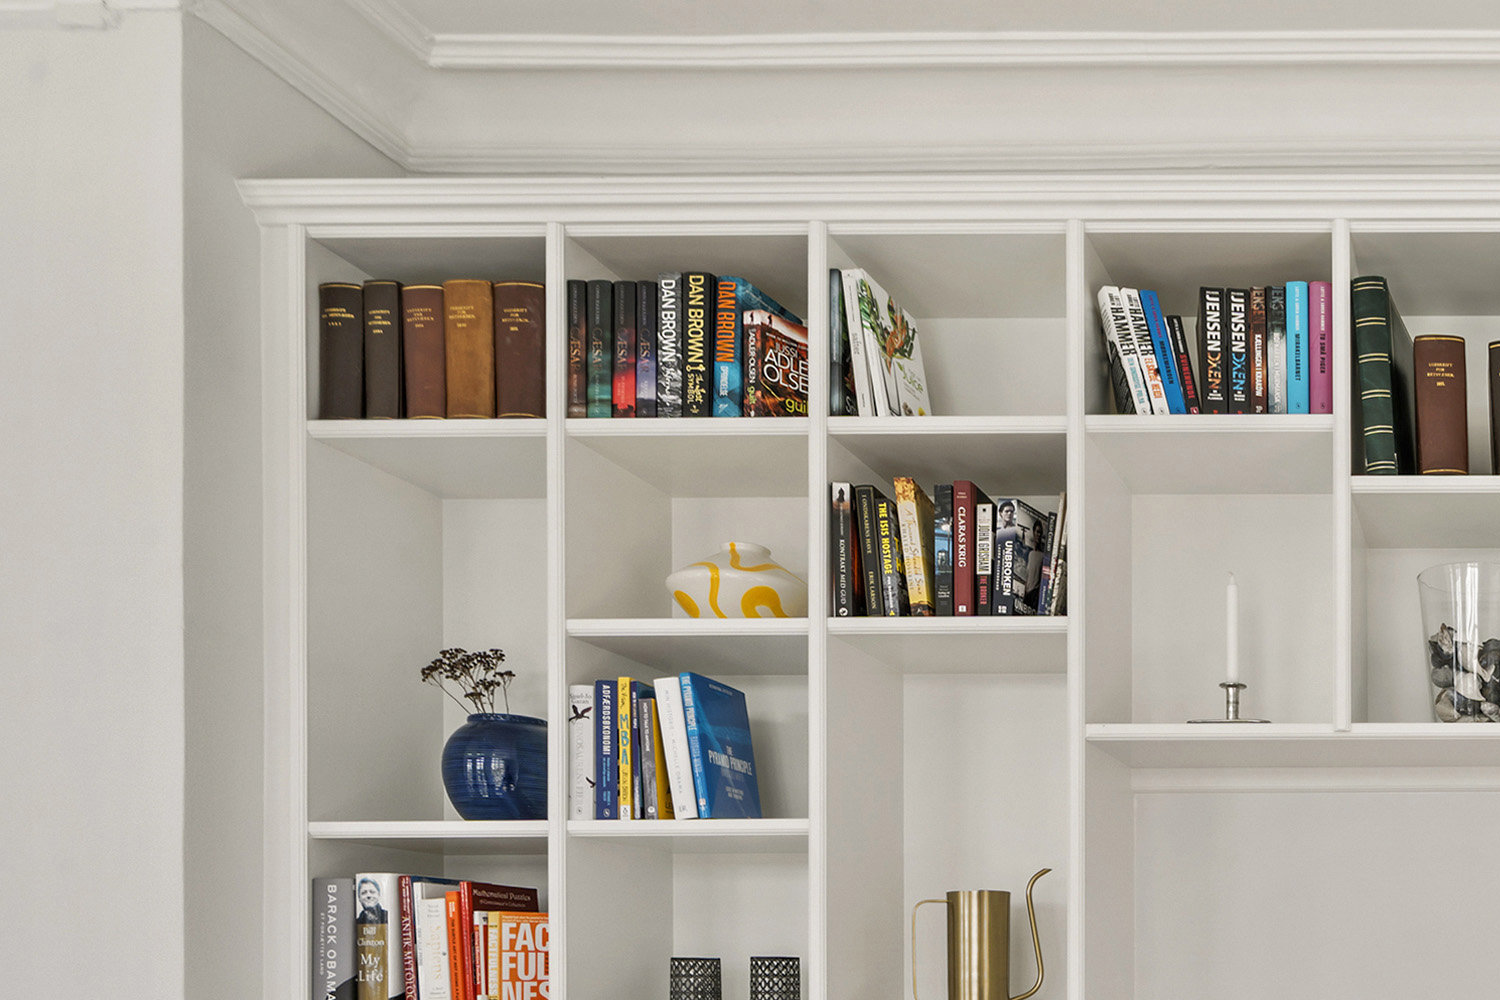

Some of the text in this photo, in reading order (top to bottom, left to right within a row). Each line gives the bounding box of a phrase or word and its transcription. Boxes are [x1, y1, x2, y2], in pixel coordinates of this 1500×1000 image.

[661, 279, 676, 363] DAN BROWN
[687, 275, 704, 363] DAN BROWN
[716, 281, 736, 362] DAN BROWN
[1110, 307, 1138, 356] HAMMER
[1128, 307, 1155, 356] HAMMER
[1206, 293, 1221, 352] JENSEN
[1231, 296, 1246, 353] JENSEN
[763, 363, 809, 395] OLSE
[764, 348, 808, 378] ADLE
[687, 373, 695, 405] SYMBOL
[878, 503, 893, 574] THE ISIS HOSTAGE
[957, 506, 967, 568] CLARAS KRIG
[978, 525, 990, 542] JOHN
[978, 543, 991, 572] GRISHAM
[868, 571, 876, 585] ERIK
[1003, 541, 1014, 596] UNBROKEN
[870, 586, 878, 609] LARSON
[603, 684, 611, 756] ADFÆRDSØKONOMI
[708, 749, 753, 776] PYRAMID PRINCIPLE
[326, 884, 337, 925] BARACK
[401, 915, 412, 950] ANTIK
[427, 925, 446, 981] Sapiens
[502, 922, 549, 951] FAC
[361, 953, 380, 969] My
[488, 928, 499, 996] FACTFULNESS
